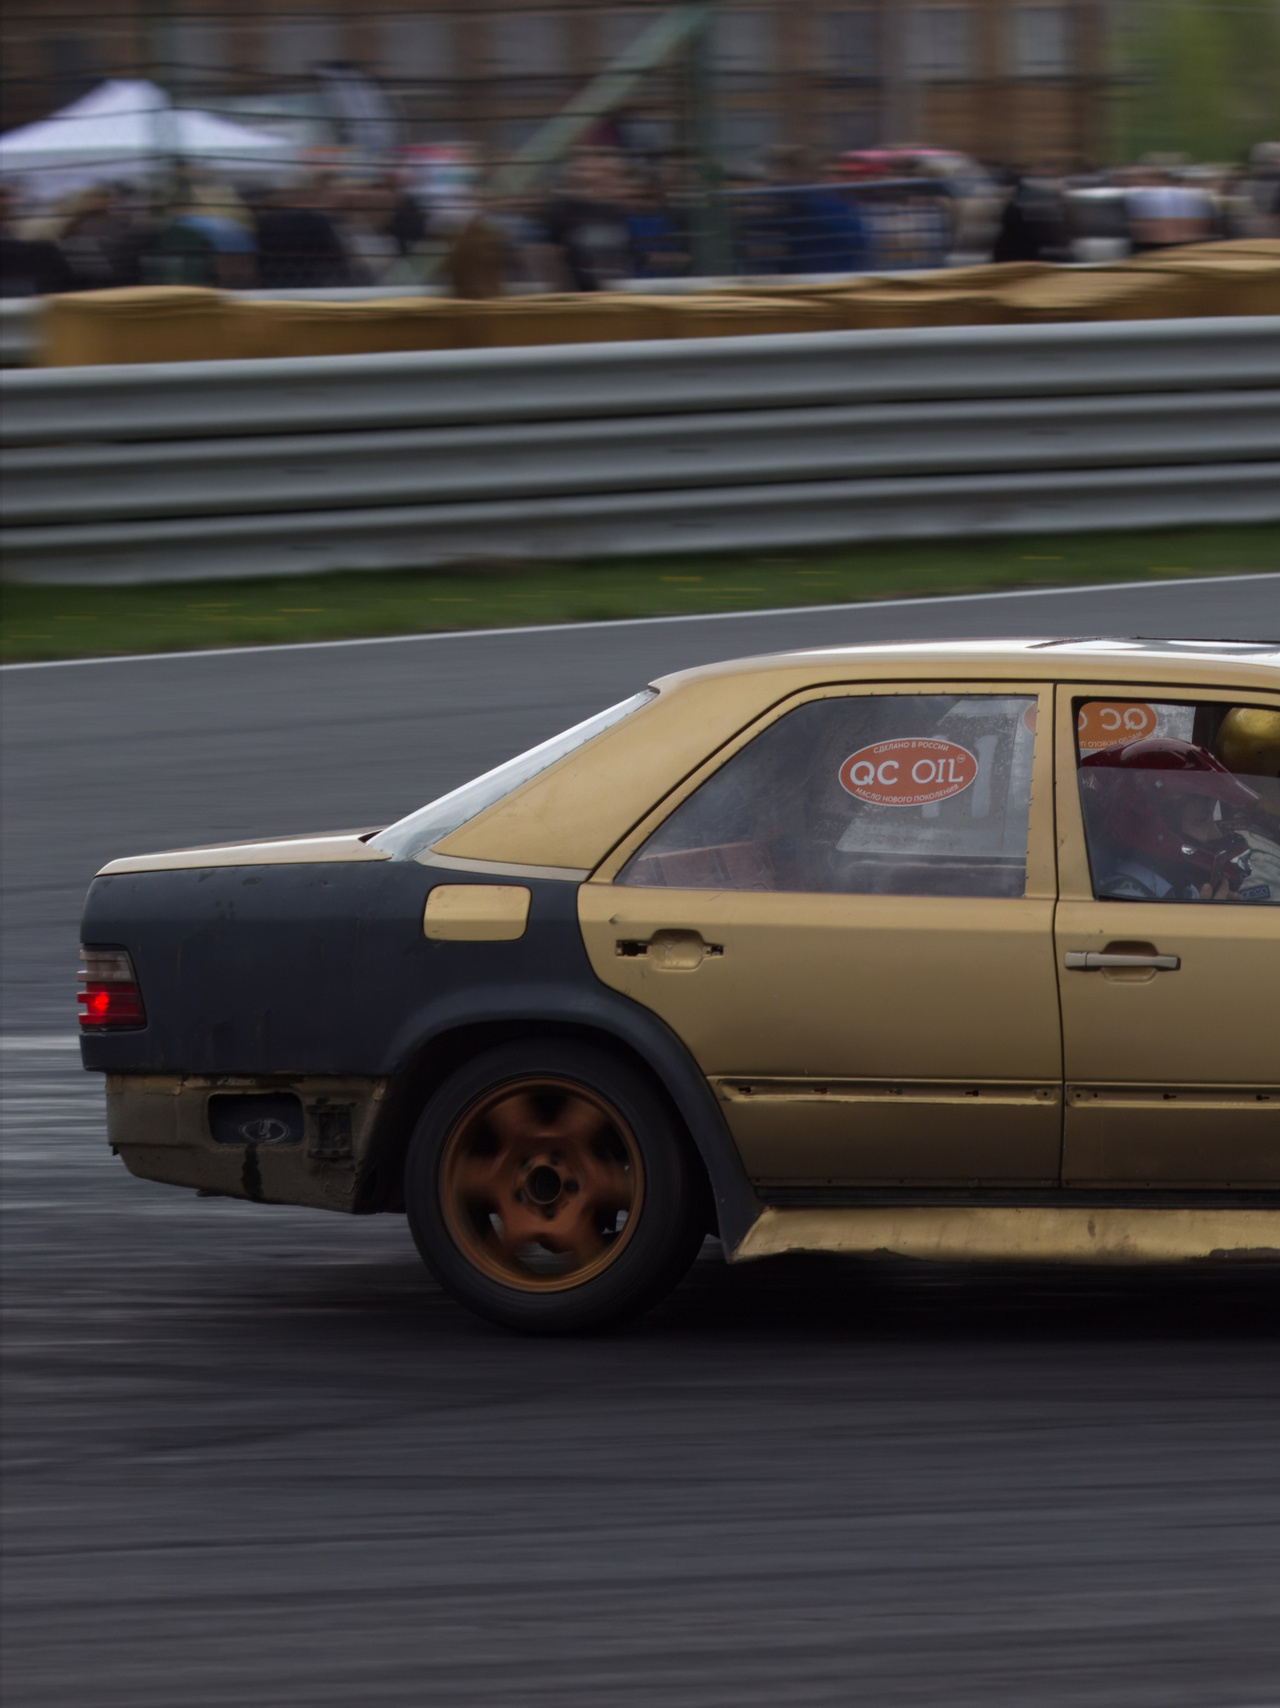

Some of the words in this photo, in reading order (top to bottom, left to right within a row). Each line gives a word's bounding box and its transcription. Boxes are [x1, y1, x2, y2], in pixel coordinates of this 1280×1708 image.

[873, 741, 910, 754] СДЕЛАНО
[917, 741, 949, 752] РОССИИ
[850, 760, 899, 786] QC
[911, 759, 964, 784] OIL
[855, 787, 881, 801] МАСЛО
[882, 795, 913, 803] НОВОГО
[913, 784, 959, 802] ПОКОЛЕНИЯ
